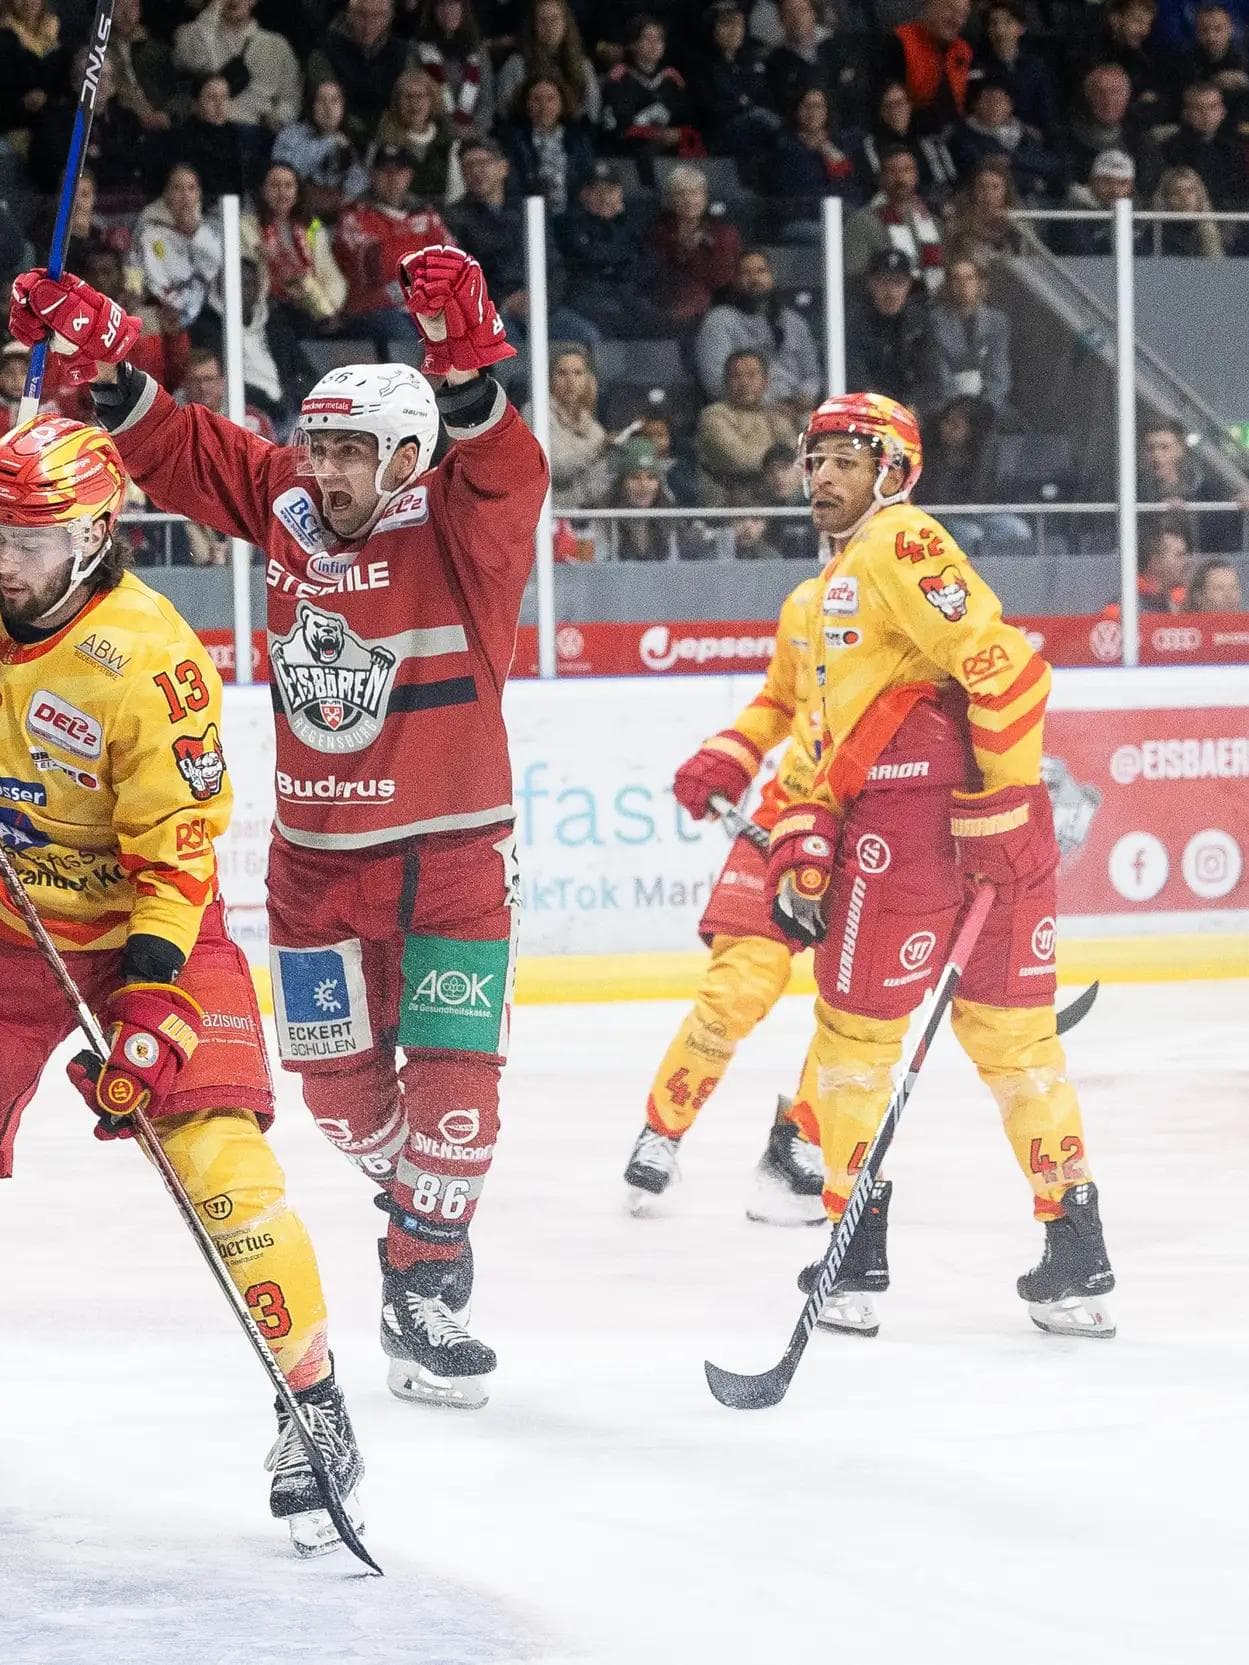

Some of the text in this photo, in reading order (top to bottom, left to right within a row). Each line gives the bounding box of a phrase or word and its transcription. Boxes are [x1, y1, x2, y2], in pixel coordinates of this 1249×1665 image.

[80, 13, 112, 110] SYNC
[382, 493, 423, 521] EL2
[79, 633, 132, 670] ABW
[152, 659, 210, 724] 13
[278, 659, 390, 714] EISBÄREN
[293, 716, 378, 749] REGENSBURG
[836, 874, 867, 994] WARRIOR
[412, 970, 495, 1008] AOK
[202, 1009, 250, 1031] äzision
[289, 1021, 353, 1041] ECKERT
[290, 1038, 357, 1058] SCHULEN
[1030, 1135, 1085, 1183] 42
[412, 1172, 472, 1220] 86
[216, 1232, 275, 1259] bertus
[244, 1279, 293, 1340] 3
